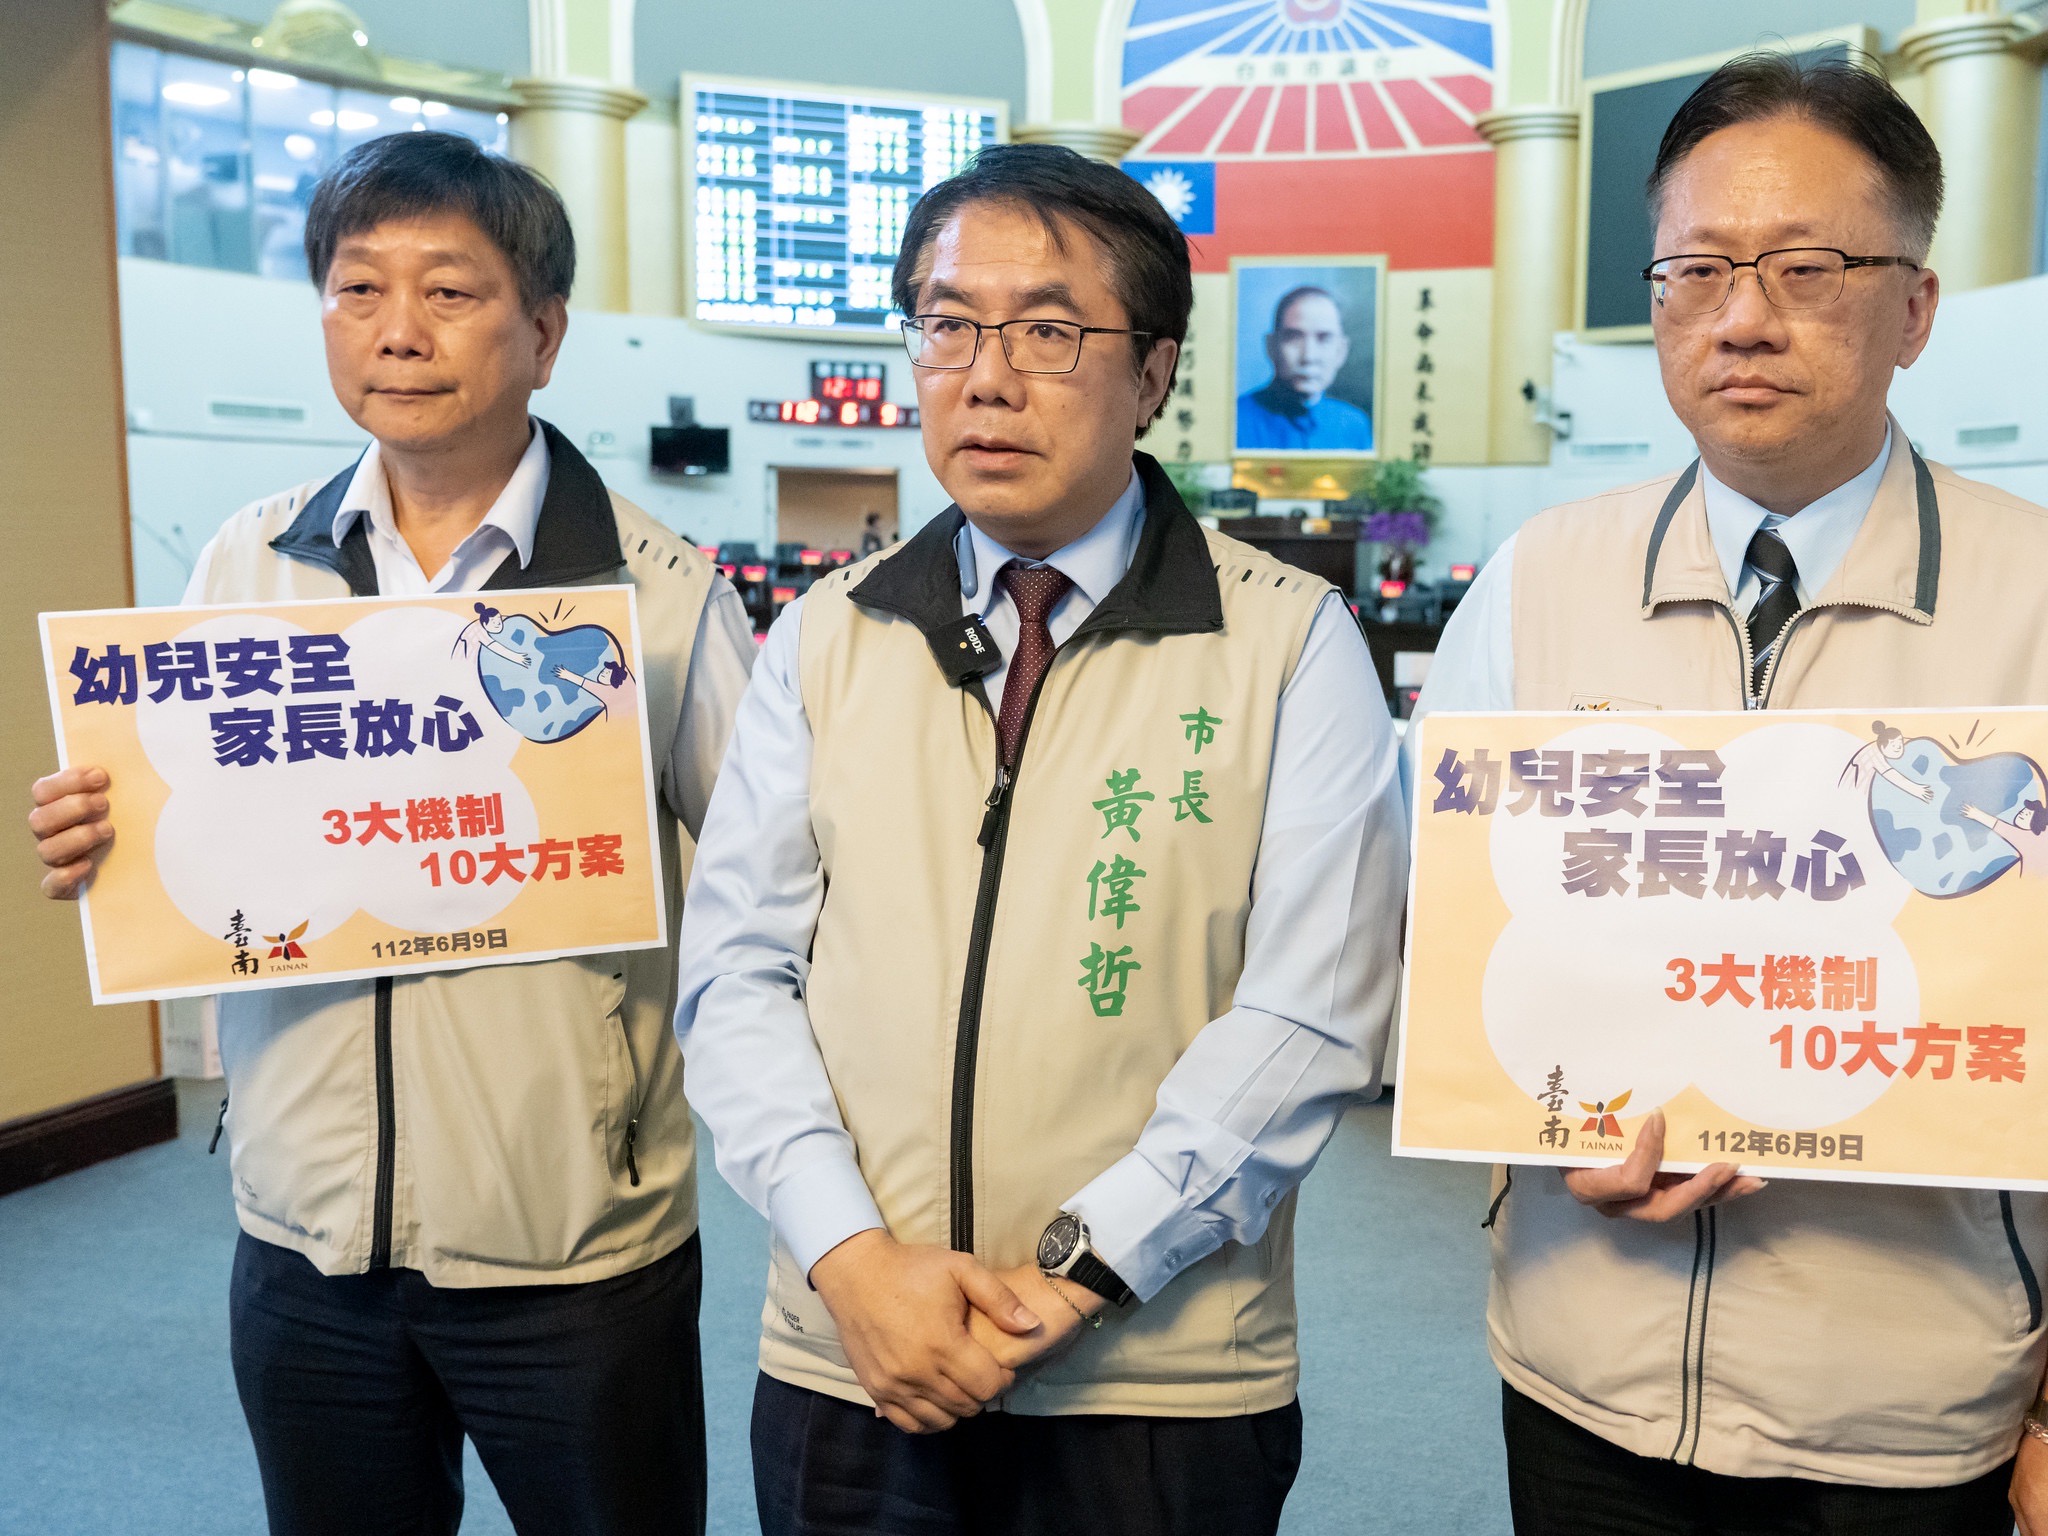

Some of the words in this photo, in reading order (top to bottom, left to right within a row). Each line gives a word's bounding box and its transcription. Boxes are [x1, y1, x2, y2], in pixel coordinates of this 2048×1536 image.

[69, 634, 355, 706] 幼兒安全
[965, 627, 986, 655] RØDE
[209, 695, 484, 767] 家長放心
[1169, 706, 1222, 824] 市長
[1434, 748, 1726, 817] 幼兒安全
[323, 793, 504, 845] 3大機制
[420, 834, 625, 887] 10大方案
[1561, 829, 1866, 901] 家長放心
[1078, 768, 1155, 1017] 黃偉哲
[269, 962, 309, 973] TAINAN
[372, 929, 508, 959] 112年6月9日
[1664, 954, 1879, 1012] 3大機制
[1770, 1021, 2026, 1083] 10大方案
[1579, 1140, 1623, 1152] TAINAN
[1698, 1130, 1863, 1161] 112年6月9日
